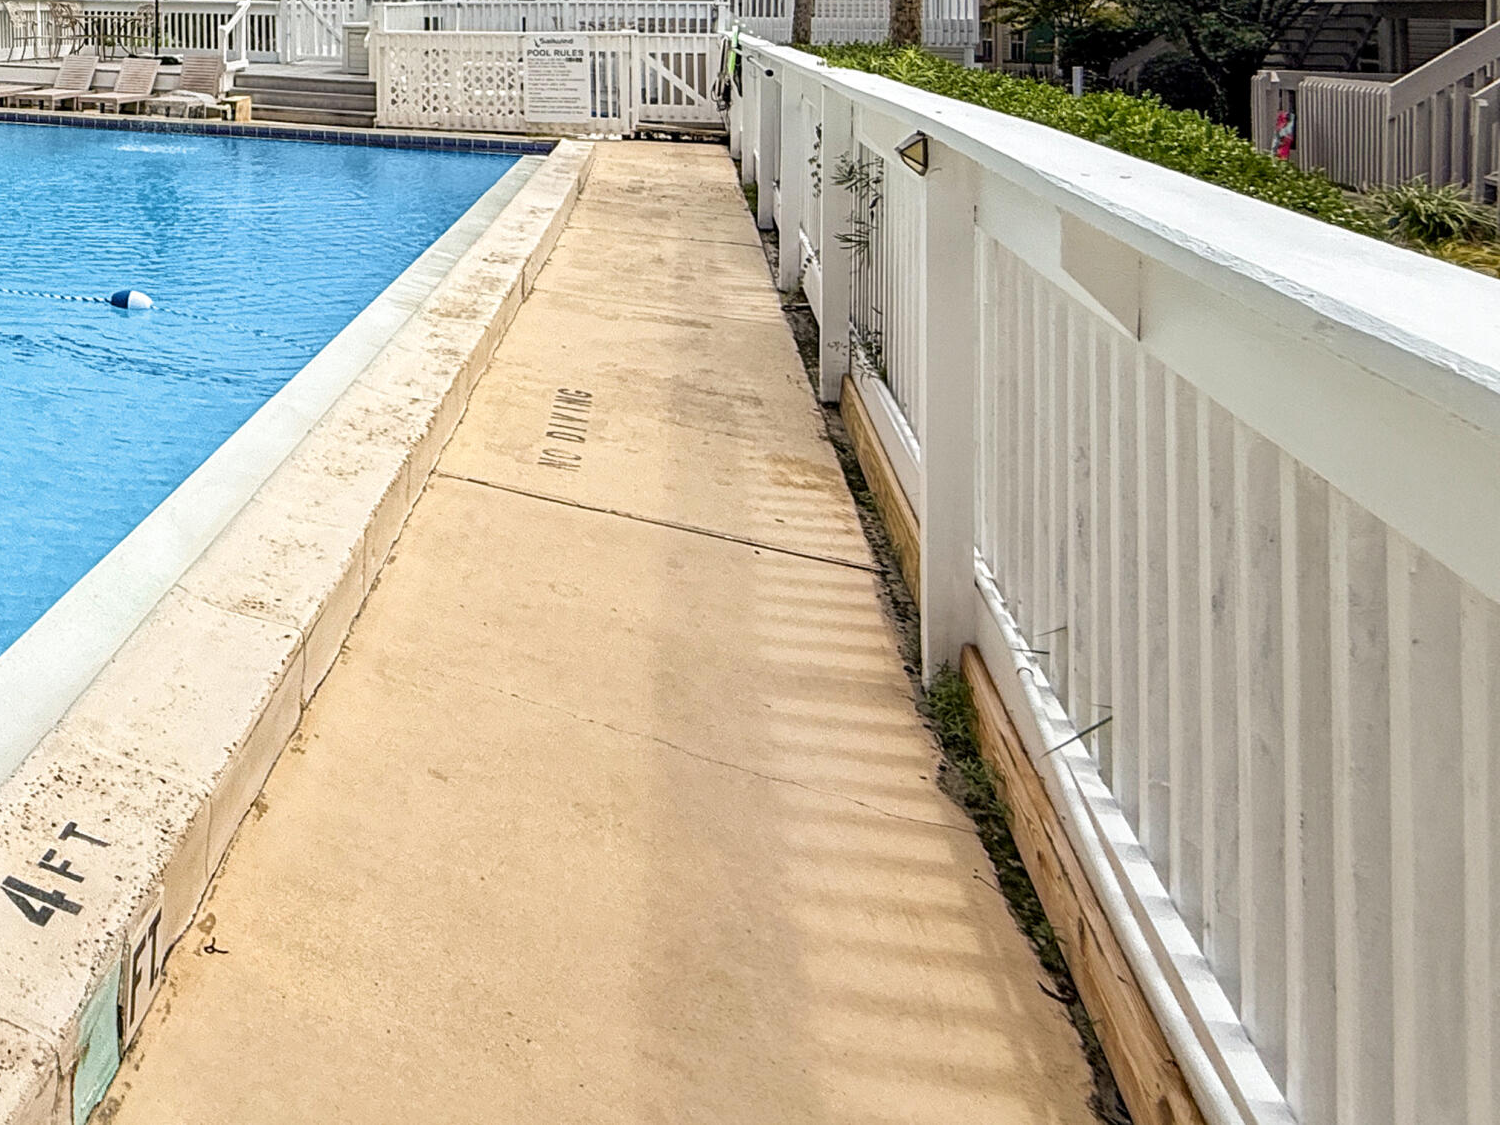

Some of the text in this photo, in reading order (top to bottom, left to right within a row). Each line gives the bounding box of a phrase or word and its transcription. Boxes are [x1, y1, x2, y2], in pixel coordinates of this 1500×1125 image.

[527, 49, 584, 57] POOL RULES
[537, 388, 593, 472] NO DIVING
